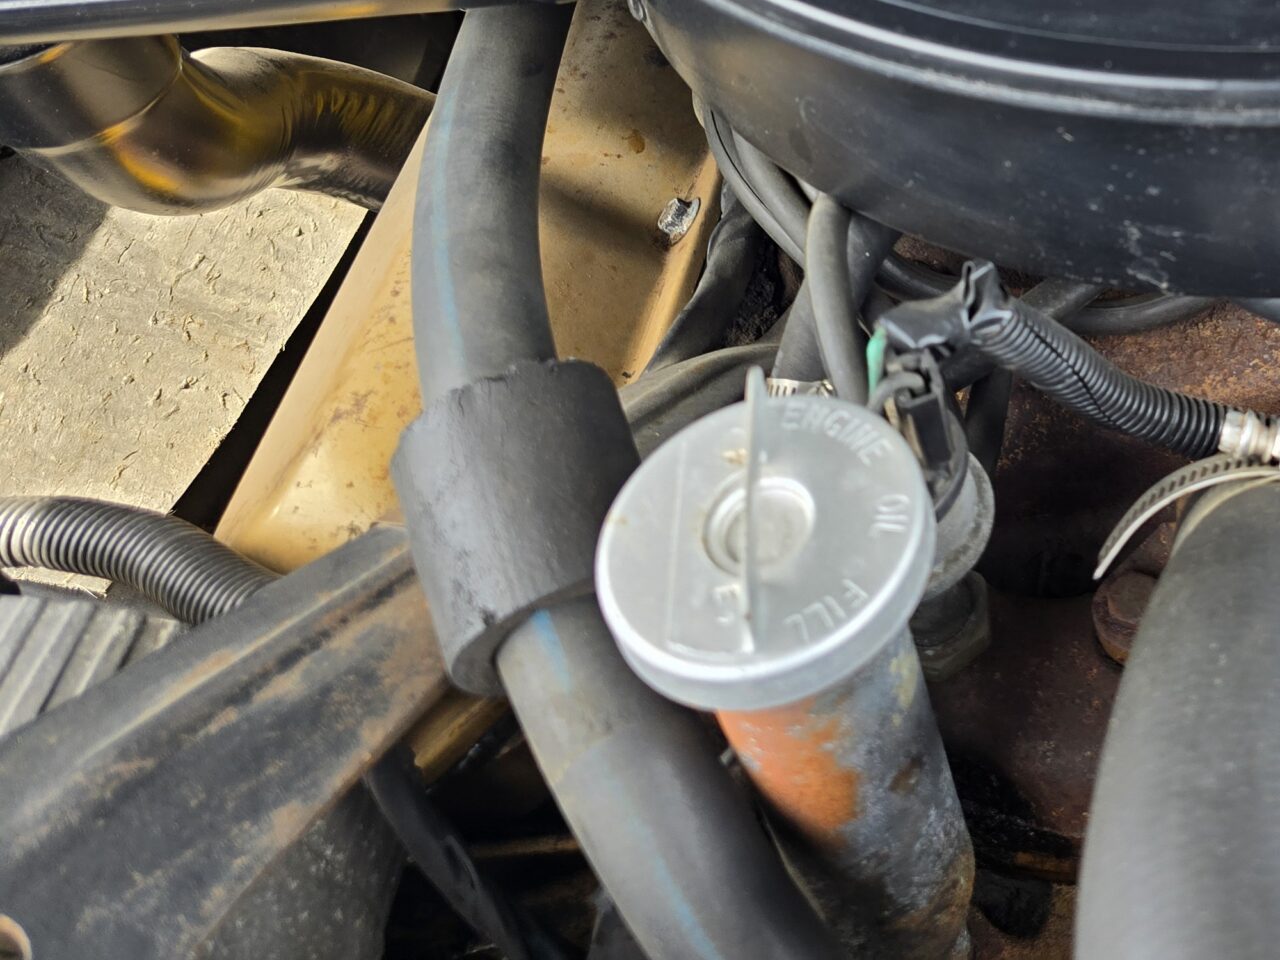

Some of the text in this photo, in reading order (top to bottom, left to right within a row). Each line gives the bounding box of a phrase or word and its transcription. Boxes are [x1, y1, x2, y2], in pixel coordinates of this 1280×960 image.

[780, 399, 910, 643] ENGINE OIL FILL
